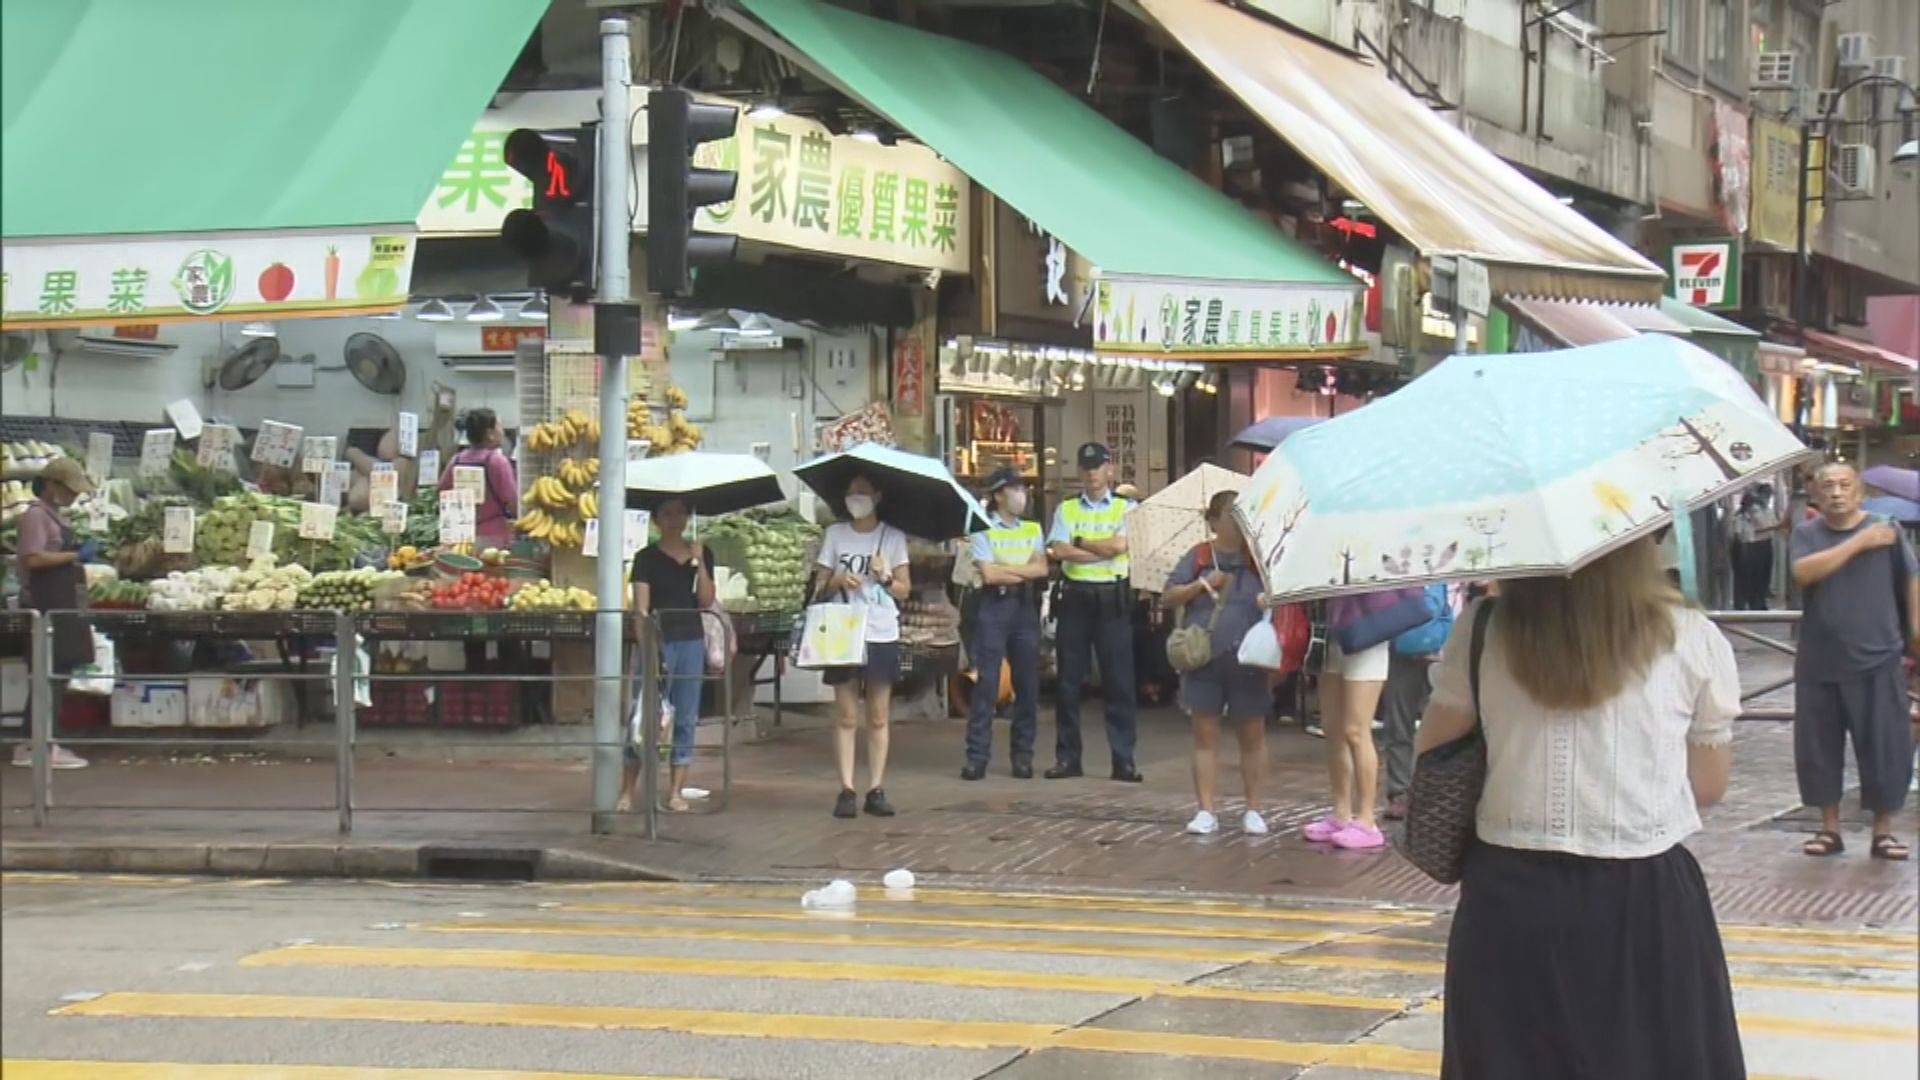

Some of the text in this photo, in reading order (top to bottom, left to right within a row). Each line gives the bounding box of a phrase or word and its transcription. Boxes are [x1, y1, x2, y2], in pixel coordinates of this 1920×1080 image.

[437, 131, 533, 213] 果
[751, 124, 959, 253] 家農優質果菜
[3, 268, 148, 314] 果菜
